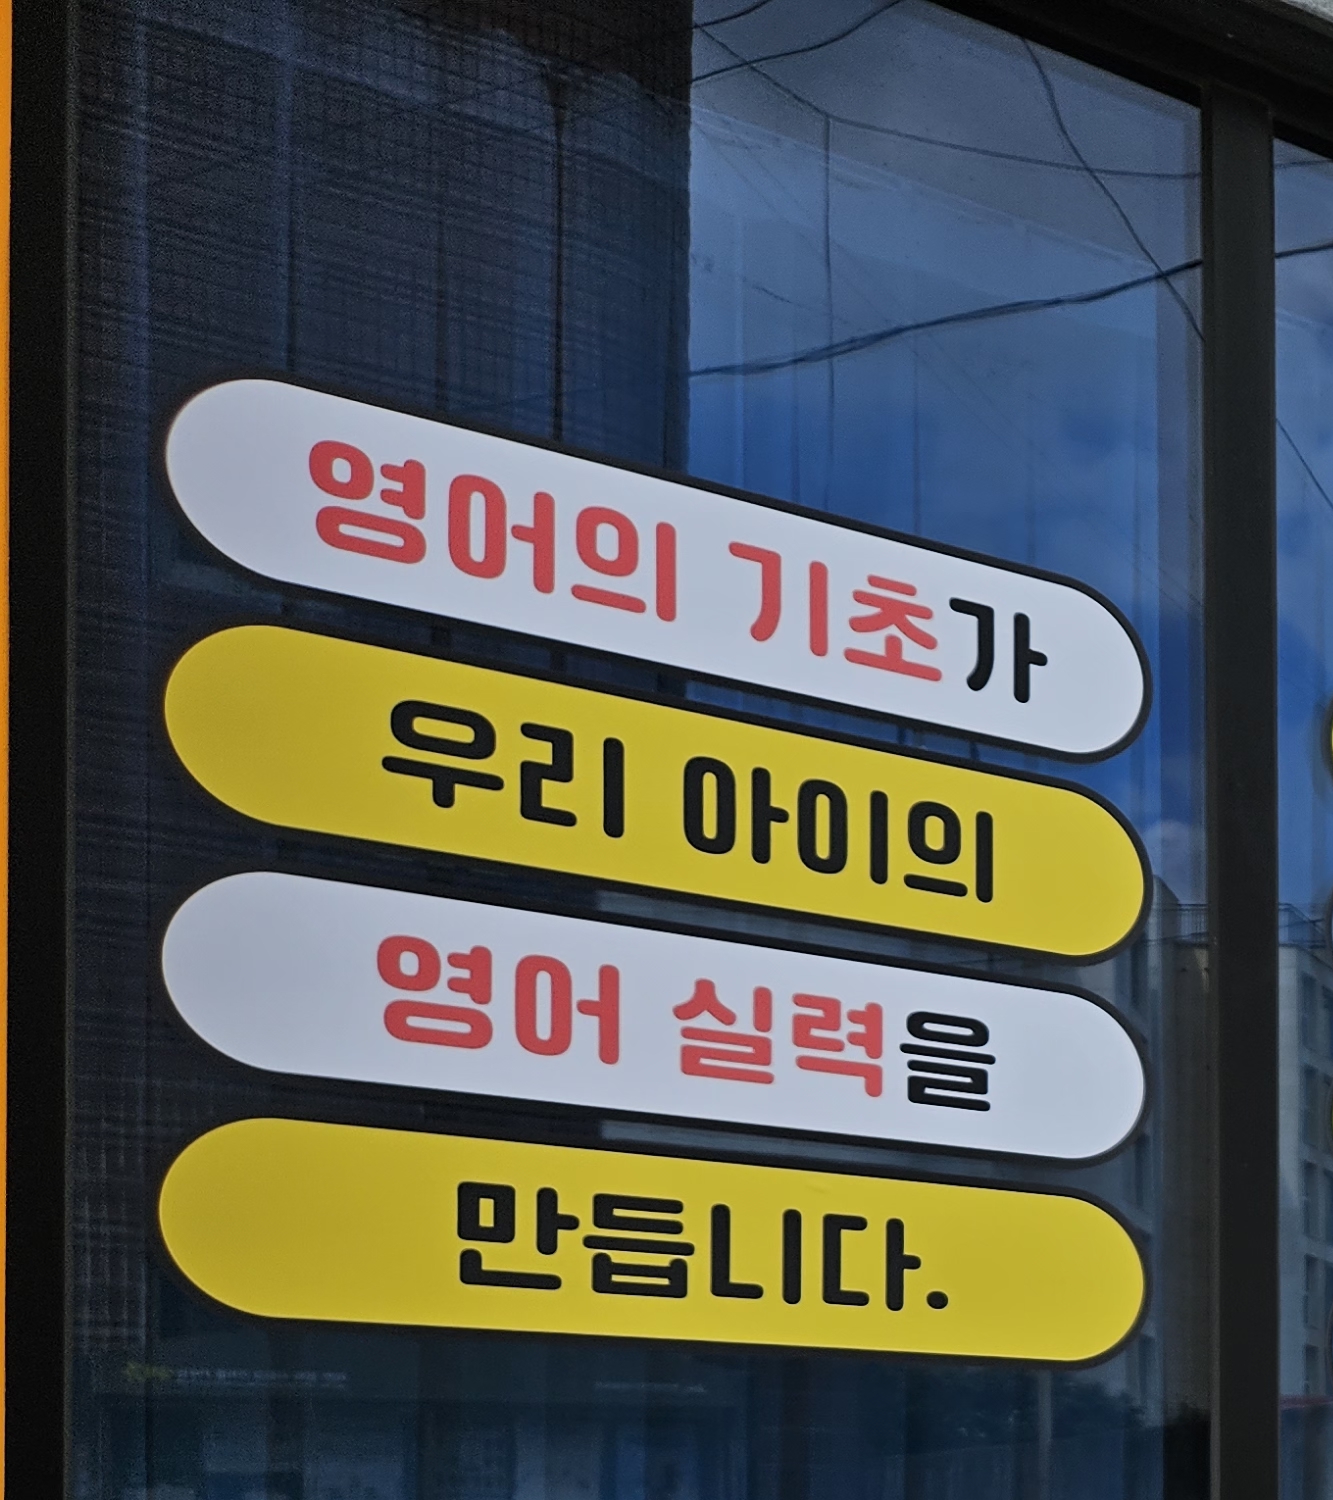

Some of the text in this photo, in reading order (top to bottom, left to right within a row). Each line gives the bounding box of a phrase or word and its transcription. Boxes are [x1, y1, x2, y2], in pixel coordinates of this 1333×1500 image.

[309, 439, 1048, 703] 영어의 기초가
[382, 699, 994, 903] 우리 아이의
[376, 935, 995, 1112] 영어 실력을
[457, 1181, 949, 1311] 만듭니다.
